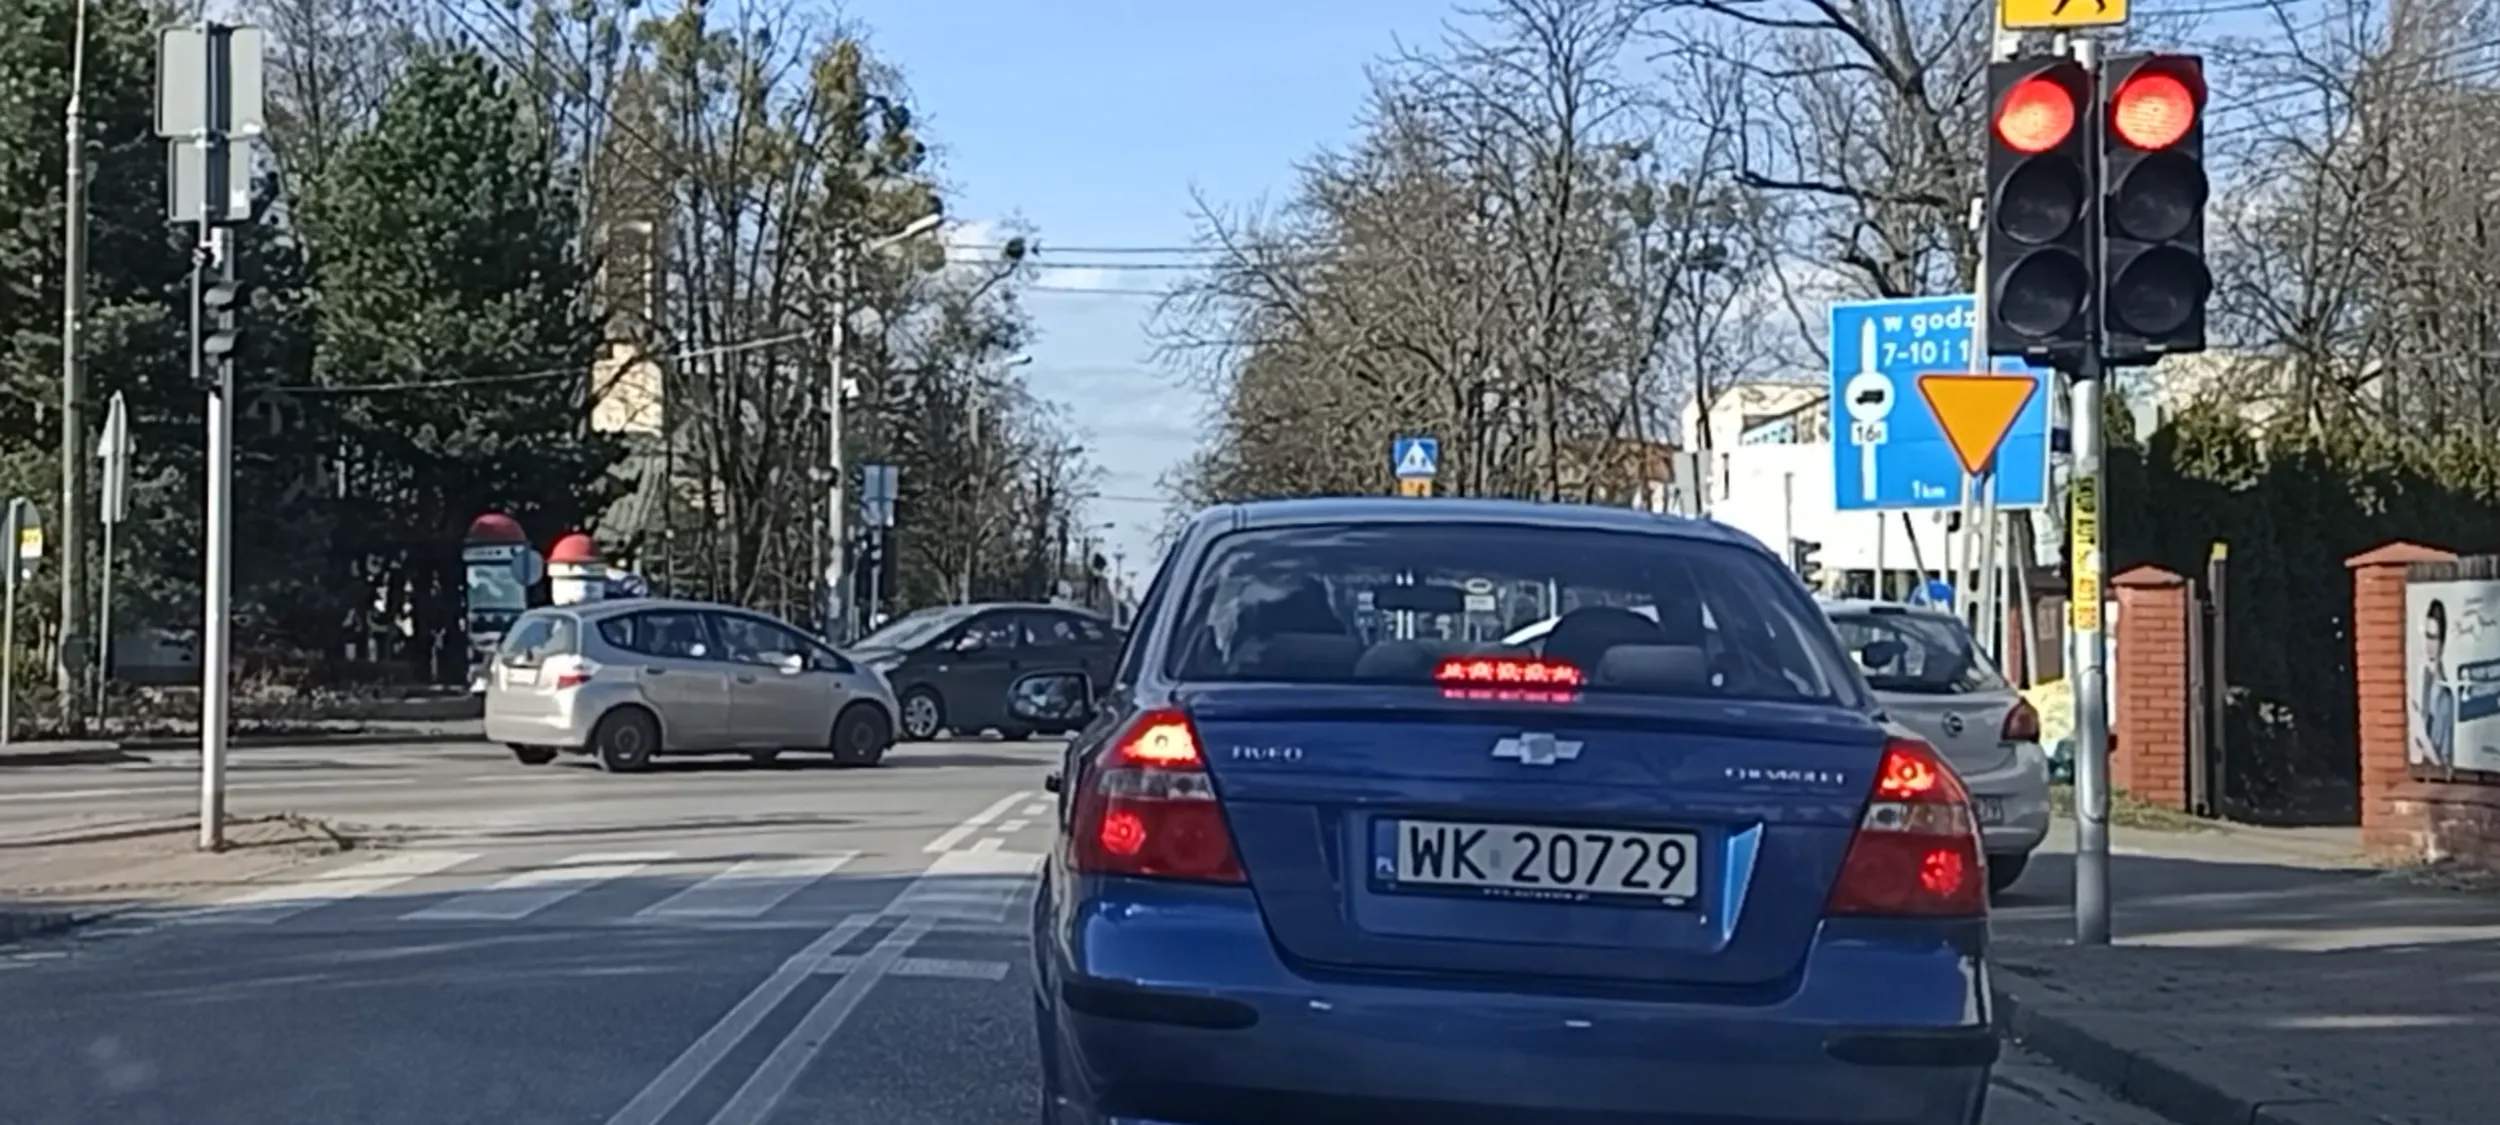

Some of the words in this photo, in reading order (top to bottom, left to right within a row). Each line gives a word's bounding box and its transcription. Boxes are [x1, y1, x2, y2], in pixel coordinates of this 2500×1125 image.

[1883, 316, 1903, 332] w
[1883, 341, 1937, 366] 7-10
[1942, 340, 1950, 364] i
[1959, 339, 1970, 363] 1
[1409, 825, 1488, 881] WK
[1510, 831, 1688, 891] 20729
